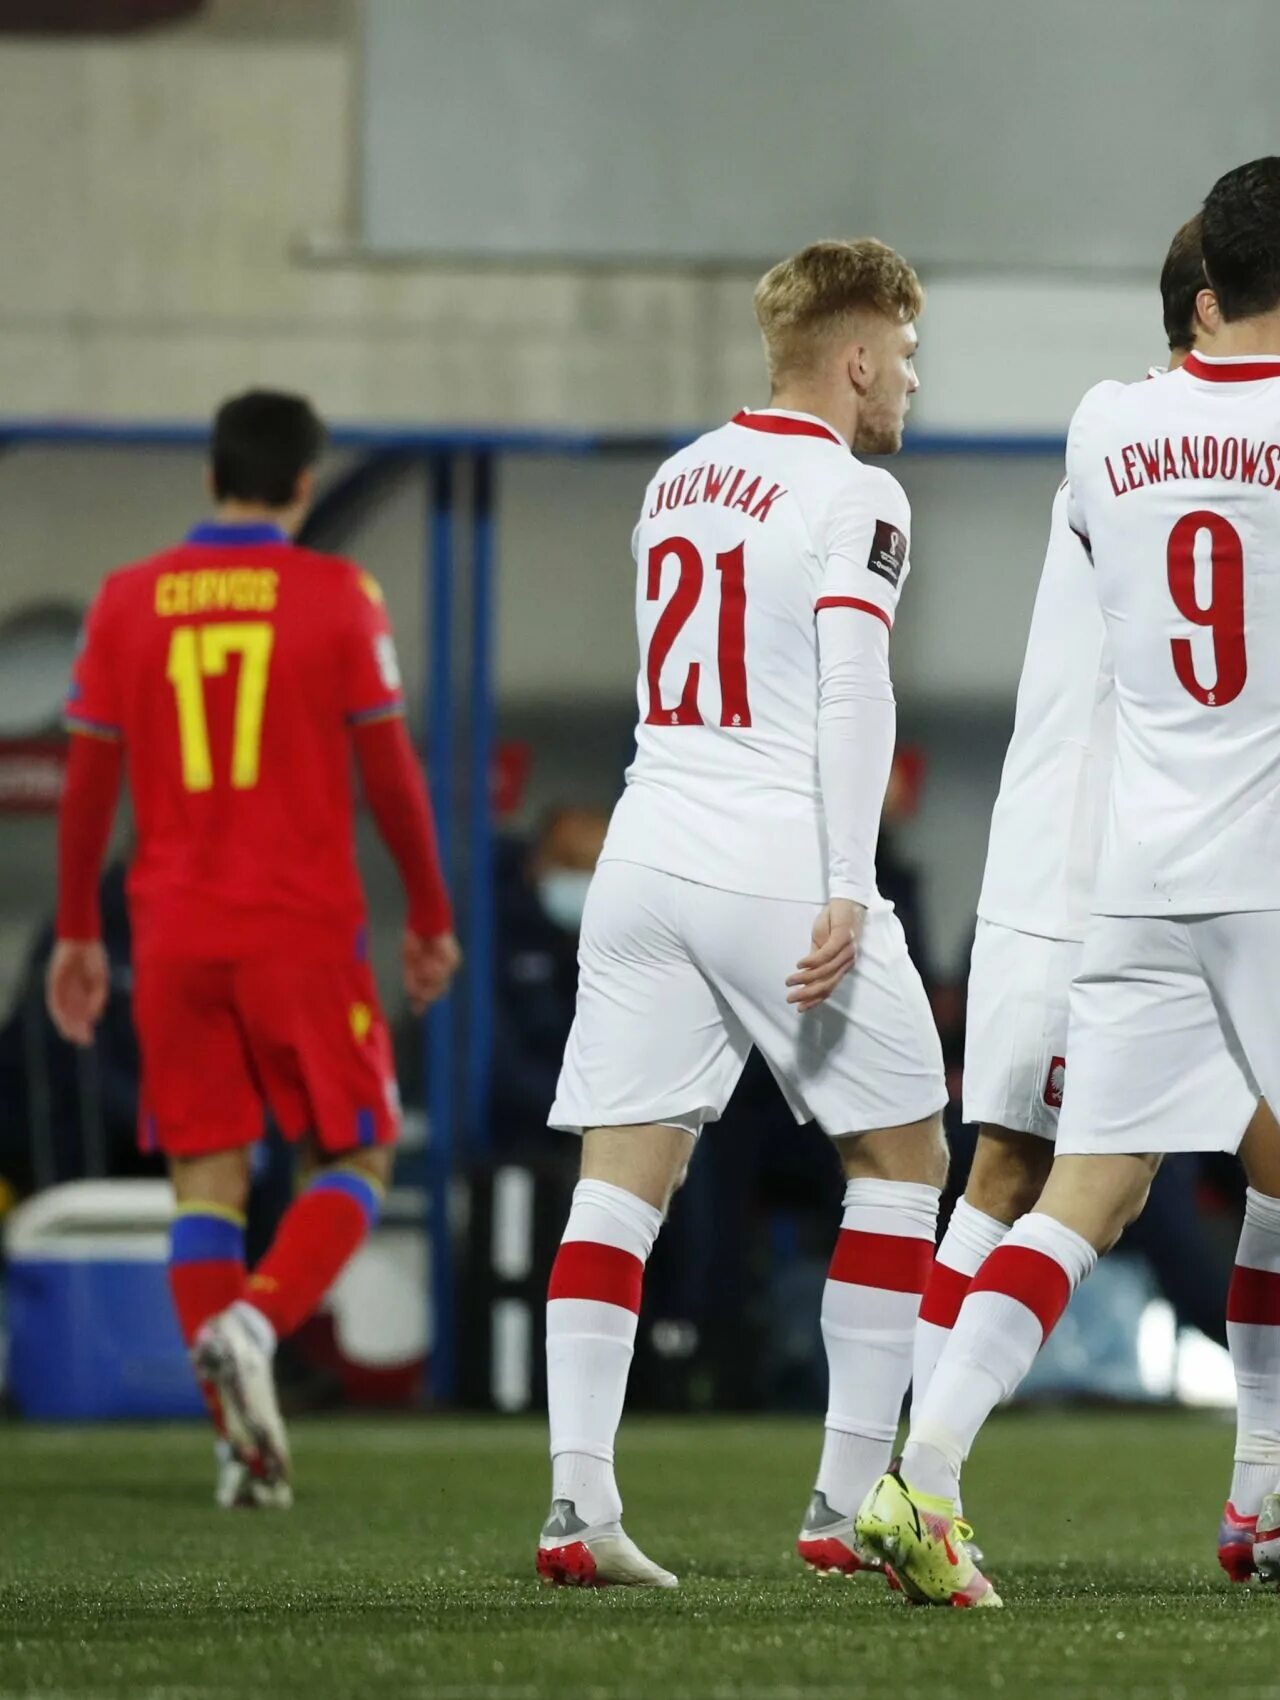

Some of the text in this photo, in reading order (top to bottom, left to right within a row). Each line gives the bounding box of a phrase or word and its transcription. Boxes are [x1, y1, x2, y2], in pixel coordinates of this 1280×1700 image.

[649, 459, 788, 523] JÓŹWIAK
[155, 567, 279, 617] CERVOS
[644, 536, 752, 727] 21
[1166, 510, 1248, 707] 9
[166, 620, 274, 793] 17
